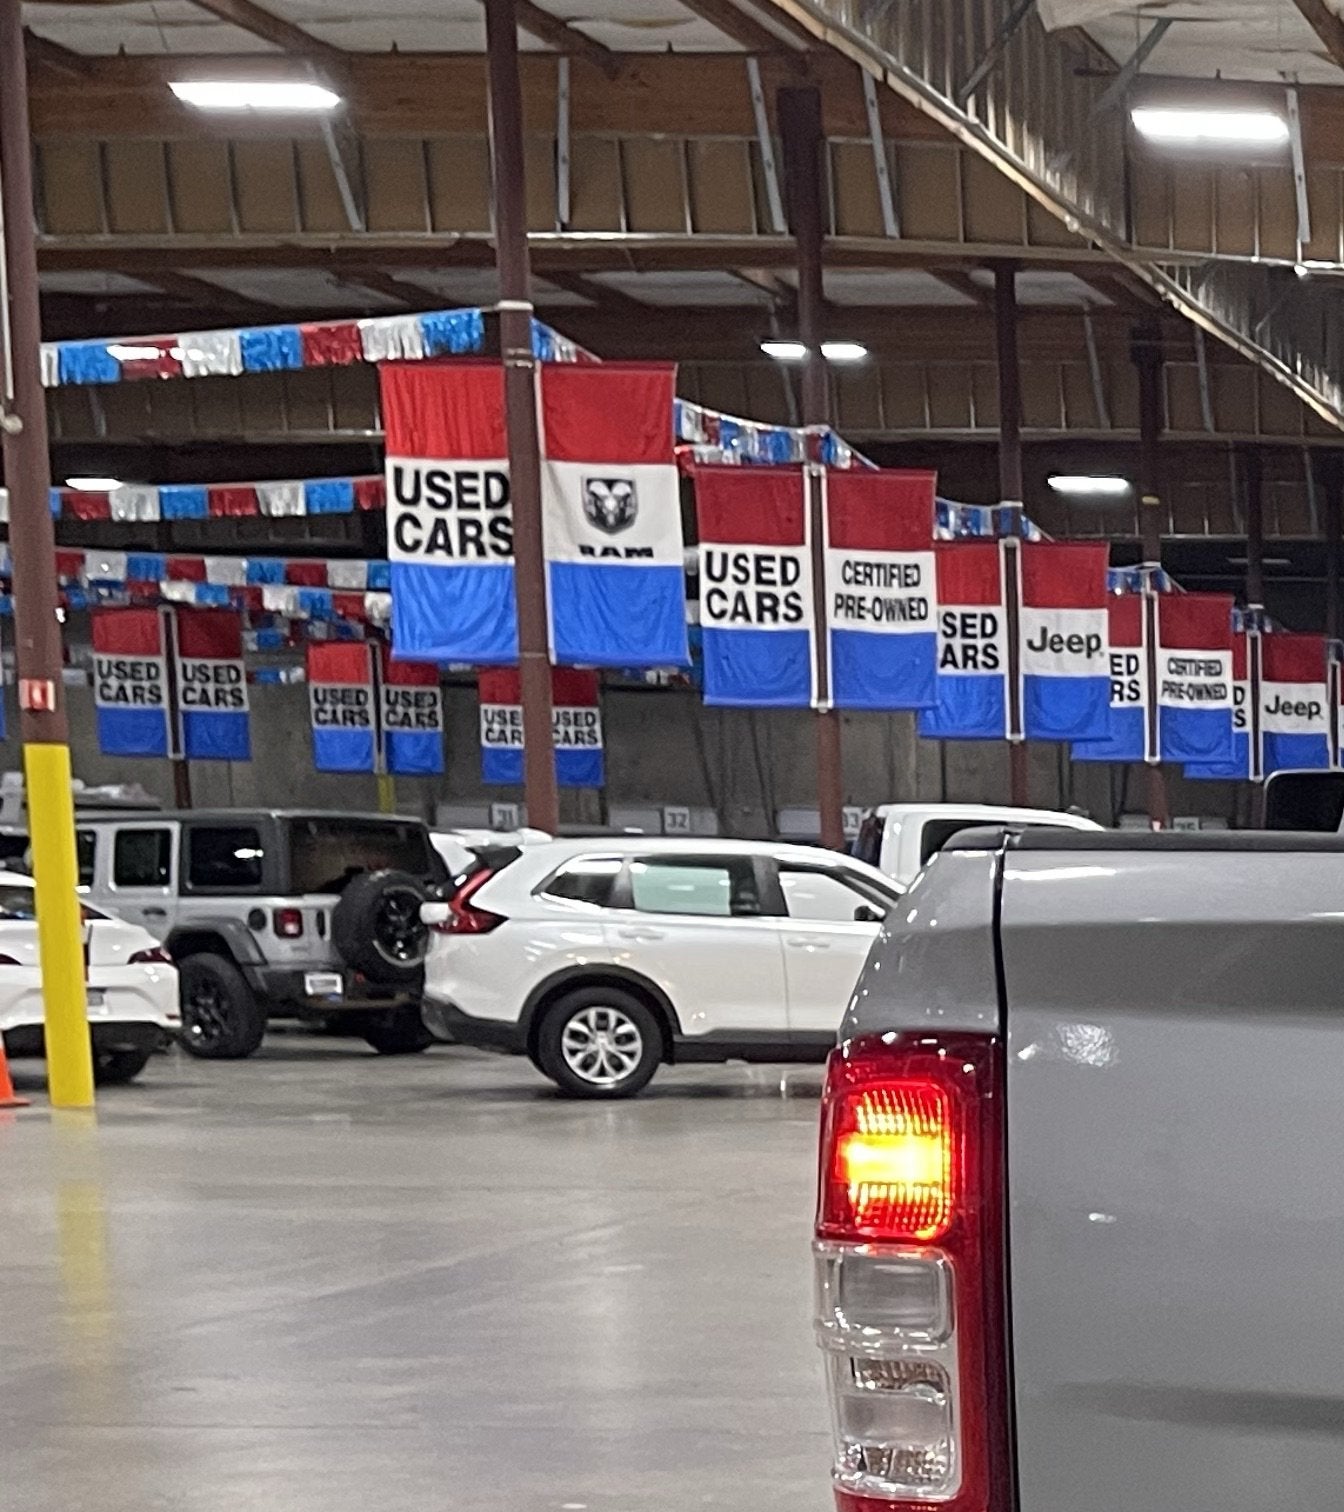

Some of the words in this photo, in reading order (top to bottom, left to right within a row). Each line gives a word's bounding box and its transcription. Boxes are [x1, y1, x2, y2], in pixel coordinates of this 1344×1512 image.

[393, 466, 510, 510] USED
[394, 513, 514, 557] CARS
[705, 551, 800, 586] USED
[842, 560, 921, 588] CERTIFIED
[706, 588, 804, 624] CARS
[834, 593, 929, 622] PRE-OWNED
[941, 611, 998, 639] SED
[1027, 626, 1102, 659] Jeep
[940, 643, 1000, 670] ARS
[1110, 653, 1140, 676] ED
[1167, 657, 1223, 677] CERTIFIED
[97, 660, 160, 680] USED
[181, 663, 242, 684] USED
[98, 684, 162, 704] CARS
[182, 686, 244, 707] CARS
[314, 688, 369, 706] USED
[385, 689, 438, 708] USED
[1110, 679, 1141, 701] RS
[1161, 683, 1227, 702] PRE-OWNED
[315, 708, 370, 726] CARS
[484, 709, 521, 726] USE
[1265, 695, 1322, 720] Jeep
[385, 709, 439, 728] CARS
[485, 728, 522, 744] CAR
